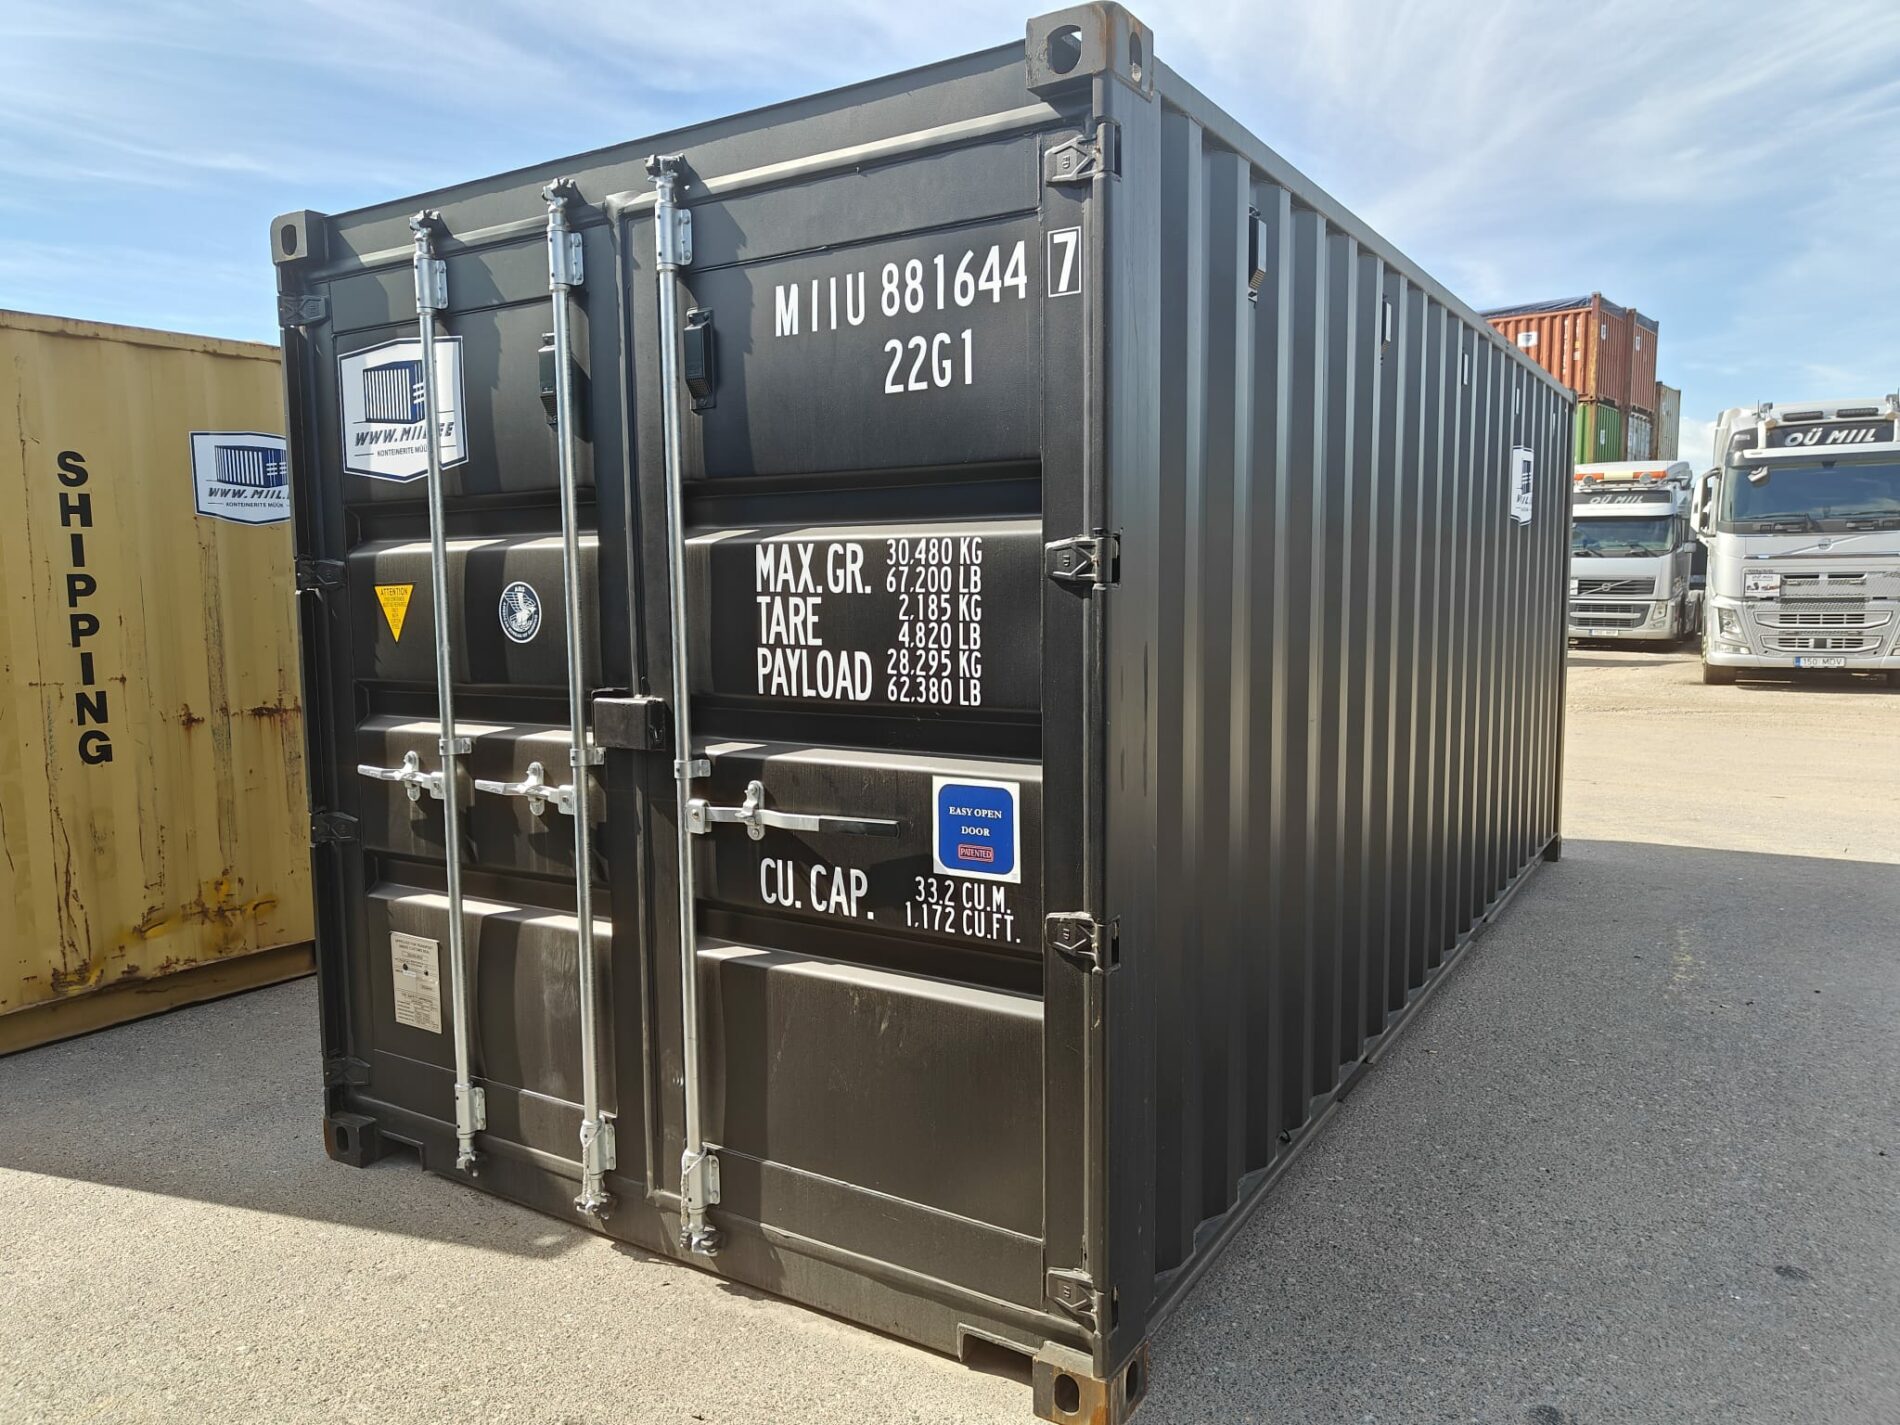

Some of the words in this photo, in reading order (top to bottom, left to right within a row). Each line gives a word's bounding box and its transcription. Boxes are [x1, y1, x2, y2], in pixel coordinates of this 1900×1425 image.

[775, 271, 865, 337] MIIU
[881, 240, 1028, 317] 881644
[1053, 230, 1078, 293] 7
[884, 328, 973, 394] 22G1
[1784, 427, 1823, 447] OÜ
[1825, 428, 1877, 444] MIIL
[886, 538, 953, 565] 30,480
[959, 536, 983, 565] KG
[886, 566, 953, 593] 67,200
[959, 566, 982, 593] LB
[56, 450, 113, 765] SHIPPING
[756, 595, 823, 646] TARE
[898, 594, 951, 621] 2,185
[959, 594, 982, 622] KG
[898, 621, 952, 649] 4,820
[959, 622, 982, 650] LB
[756, 647, 873, 701] PAYLOAD
[886, 648, 952, 676] 28,295
[959, 650, 982, 678] KG
[887, 676, 952, 705] 62,380
[959, 679, 982, 706] LB
[949, 806, 973, 816] EASY
[974, 808, 1002, 819] OPEN
[961, 826, 990, 837] DOOR
[960, 847, 992, 859] PATENTED
[760, 857, 802, 909] CU.
[810, 863, 875, 920] CAP.
[915, 876, 955, 906] 33.2
[962, 882, 1012, 914] CU.M.
[905, 901, 956, 934] 1,172
[962, 909, 1021, 943] CU.FT.
